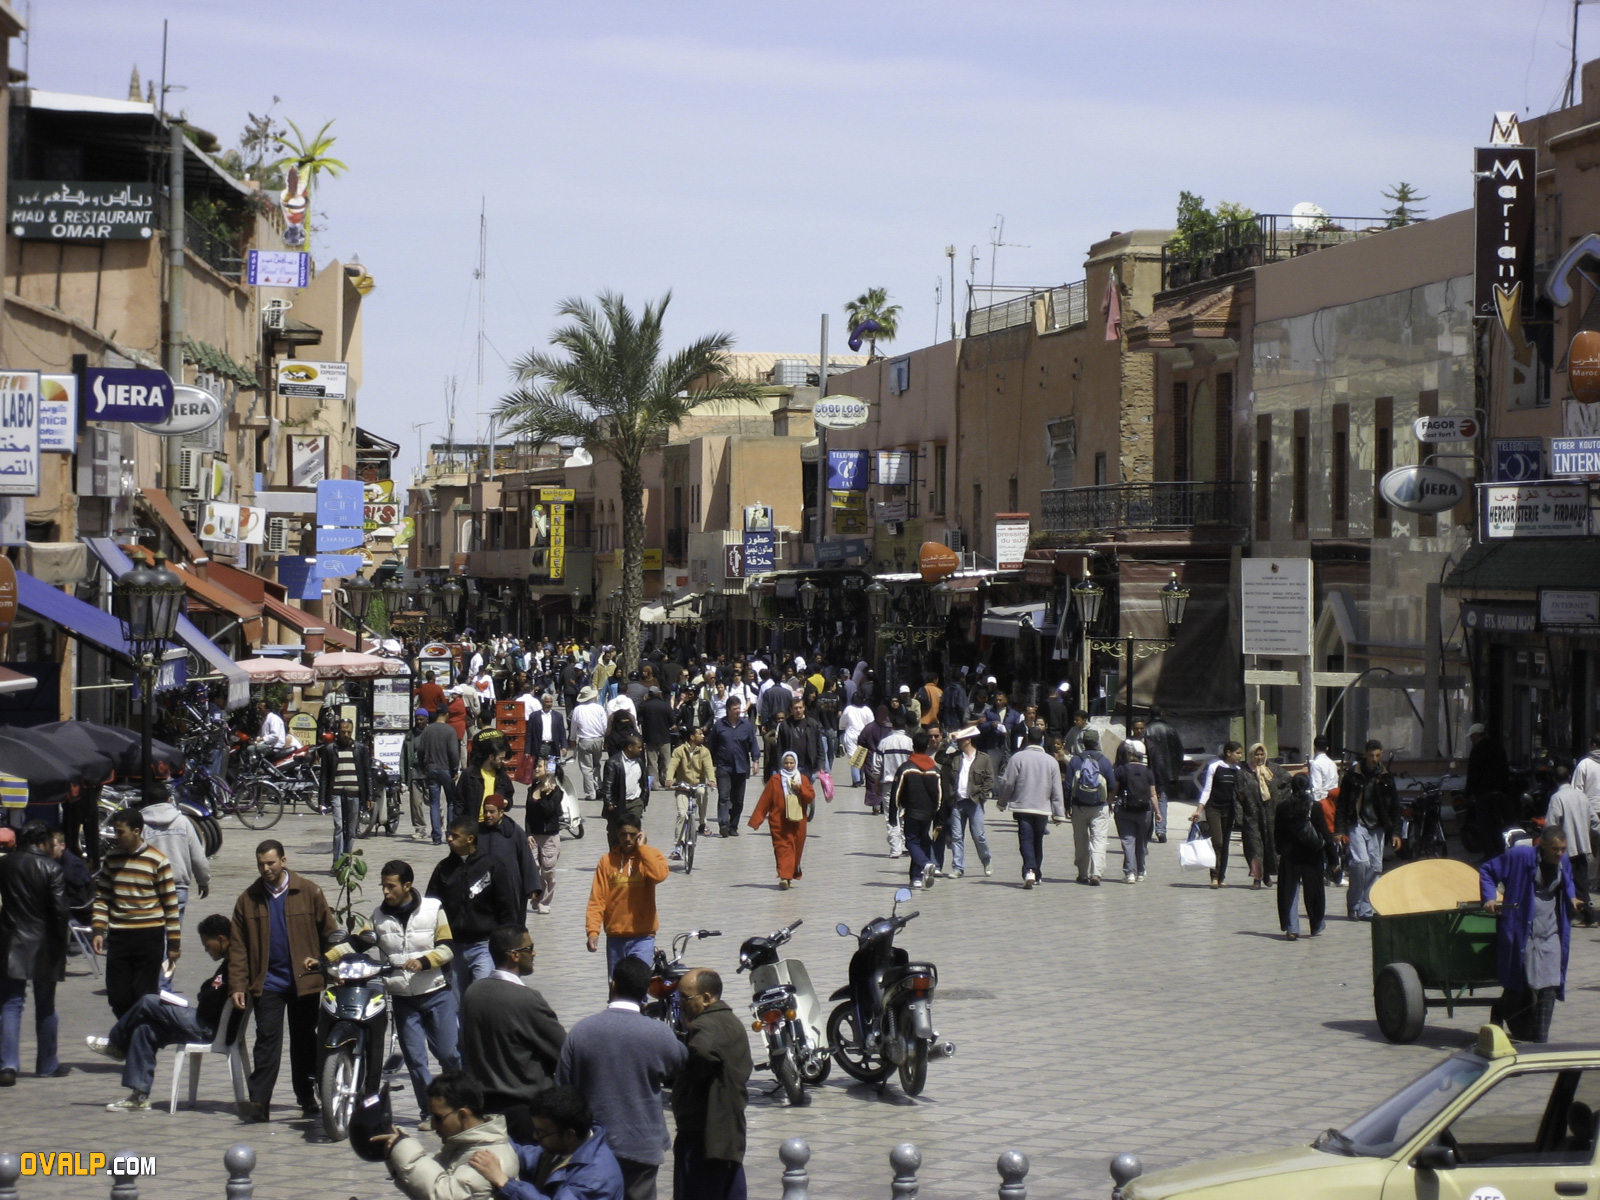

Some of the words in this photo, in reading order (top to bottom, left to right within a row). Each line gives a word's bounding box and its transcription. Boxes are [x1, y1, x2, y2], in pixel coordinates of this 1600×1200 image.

[11, 210, 45, 223] RIAD
[48, 210, 58, 223] &
[63, 210, 153, 224] RESTAURANT
[51, 224, 112, 238] OMAR
[93, 375, 165, 414] SIERA
[2, 393, 34, 428] LABO
[815, 404, 841, 414] GOOD
[842, 404, 866, 413] LOOK
[1421, 420, 1455, 430] FAGOR
[1553, 441, 1576, 450] CYBER
[1419, 477, 1458, 503] SIERA
[1489, 504, 1539, 524] HERBORISTERIE
[746, 535, 770, 545] عطور
[746, 556, 772, 565] حلاقة
[1551, 601, 1591, 610] INTERNET
